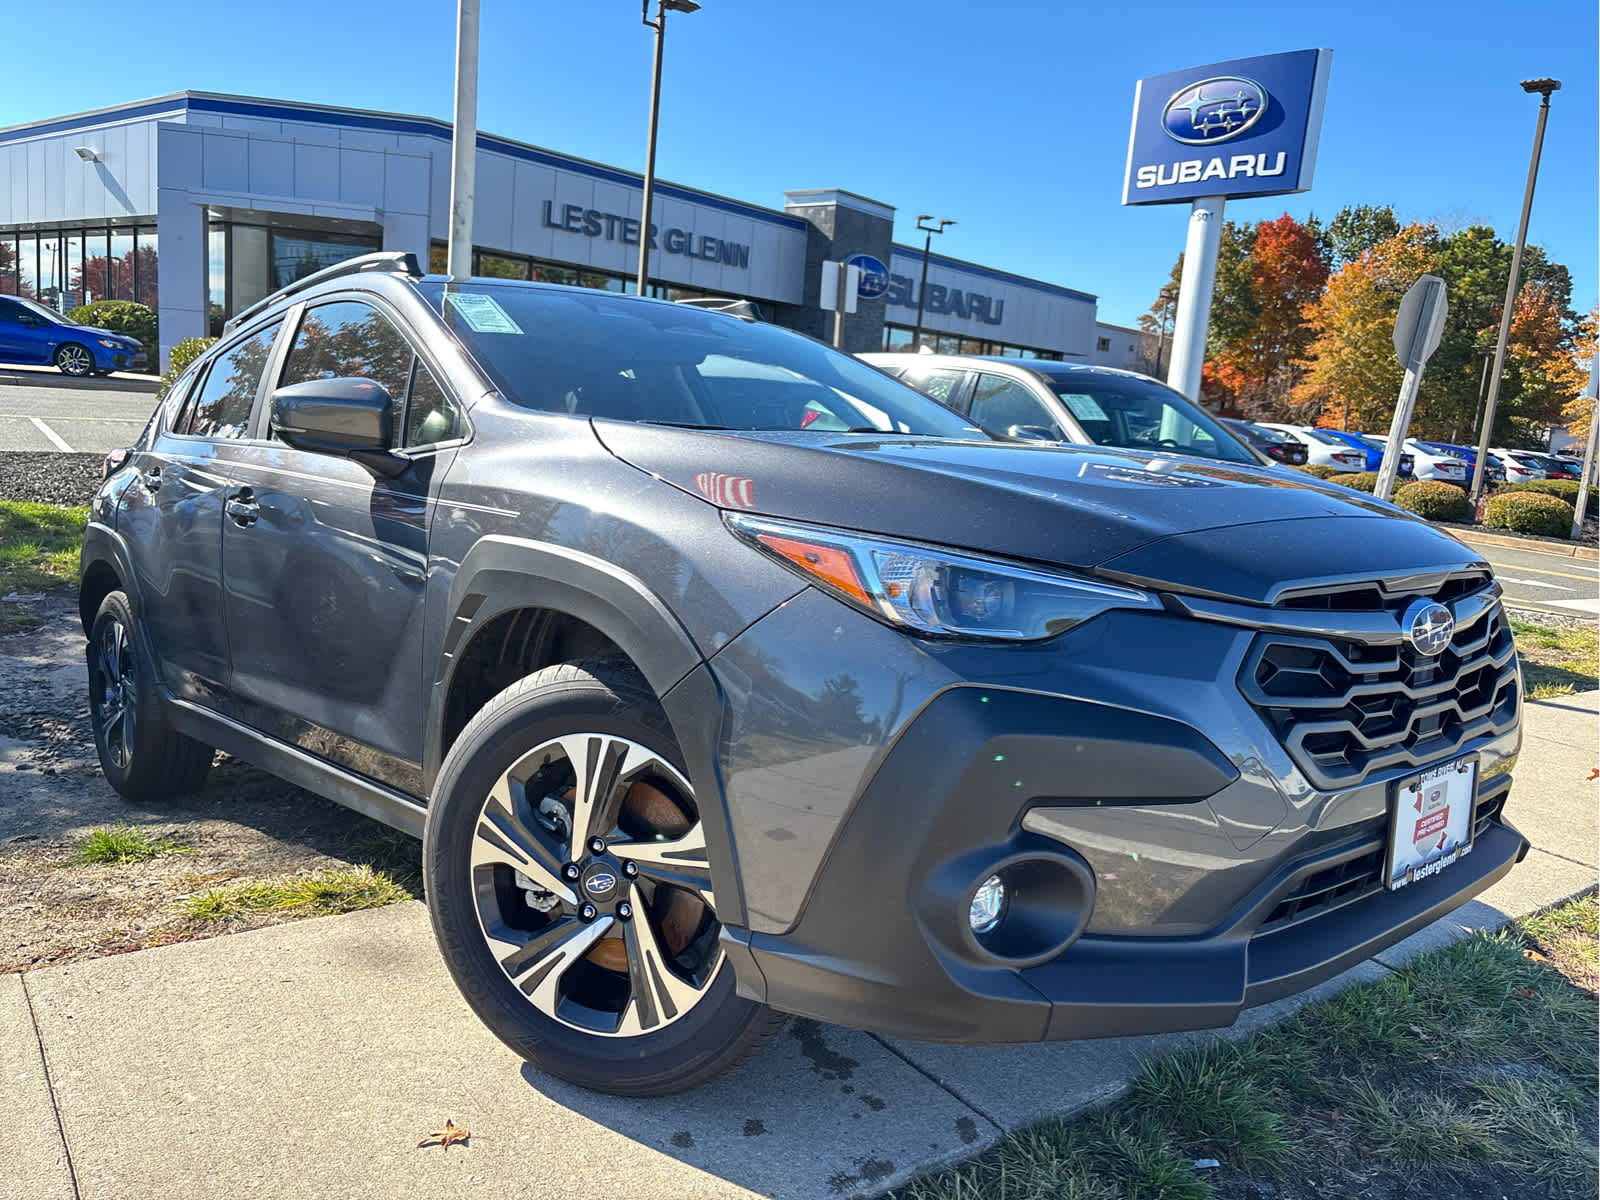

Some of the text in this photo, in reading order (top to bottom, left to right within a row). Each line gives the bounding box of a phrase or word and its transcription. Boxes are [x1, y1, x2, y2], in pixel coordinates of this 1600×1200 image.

[1136, 152, 1286, 188] SUBARU
[543, 199, 750, 270] LESTER GLENN
[885, 272, 1004, 326] SUBARU
